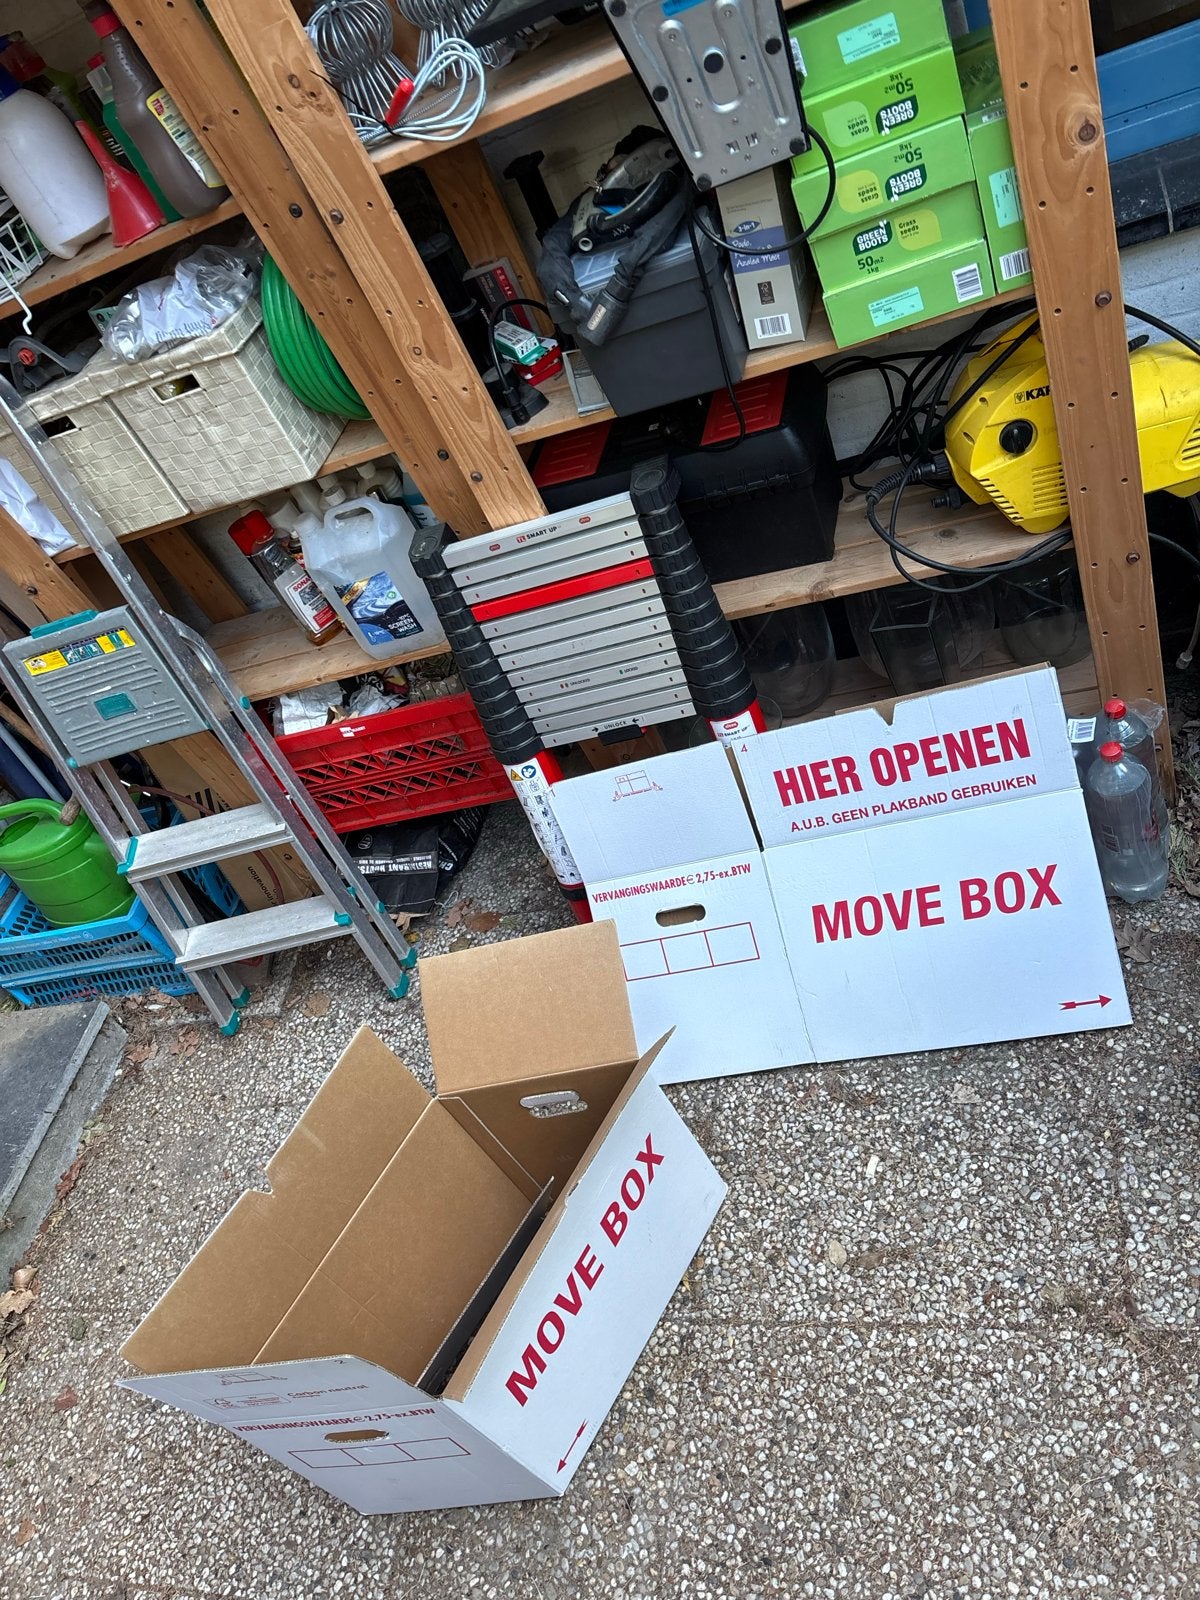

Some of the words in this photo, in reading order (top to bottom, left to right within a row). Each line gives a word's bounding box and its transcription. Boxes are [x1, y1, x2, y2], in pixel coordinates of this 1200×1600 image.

[880, 100, 912, 116] BOOTS
[848, 118, 868, 130] seeds
[882, 109, 914, 127] GREEN
[851, 126, 870, 136] Grass
[889, 168, 921, 184] BOOTS
[858, 186, 877, 197] seeds
[891, 178, 923, 194] GREEN
[861, 193, 879, 203] Grass
[898, 218, 916, 229] Grass
[900, 225, 919, 236] seeds
[856, 228, 887, 245] GREEN
[859, 234, 889, 252] BOOTS
[867, 266, 879, 275] 1kg
[526, 529, 547, 540] SMART
[292, 576, 311, 592] SONA
[388, 617, 414, 629] SCREEN
[398, 622, 417, 632] WASH
[604, 720, 627, 730] UNLOCK
[773, 756, 863, 807] HIER
[869, 718, 1031, 787] OPENEN
[791, 816, 830, 832] A.U.B.
[832, 807, 869, 824] GEEN
[873, 792, 948, 817] PLAKBAND
[951, 774, 1037, 801] GEBRUIKEN
[358, 864, 385, 874] HOUTS
[248, 865, 274, 902] innovation
[811, 884, 945, 944] MOVE
[959, 864, 1062, 921] BOX
[505, 1243, 605, 1407] MOVE
[600, 1132, 664, 1247] BOX
[287, 1388, 326, 1398] Carbon
[328, 1384, 369, 1394] neutral
